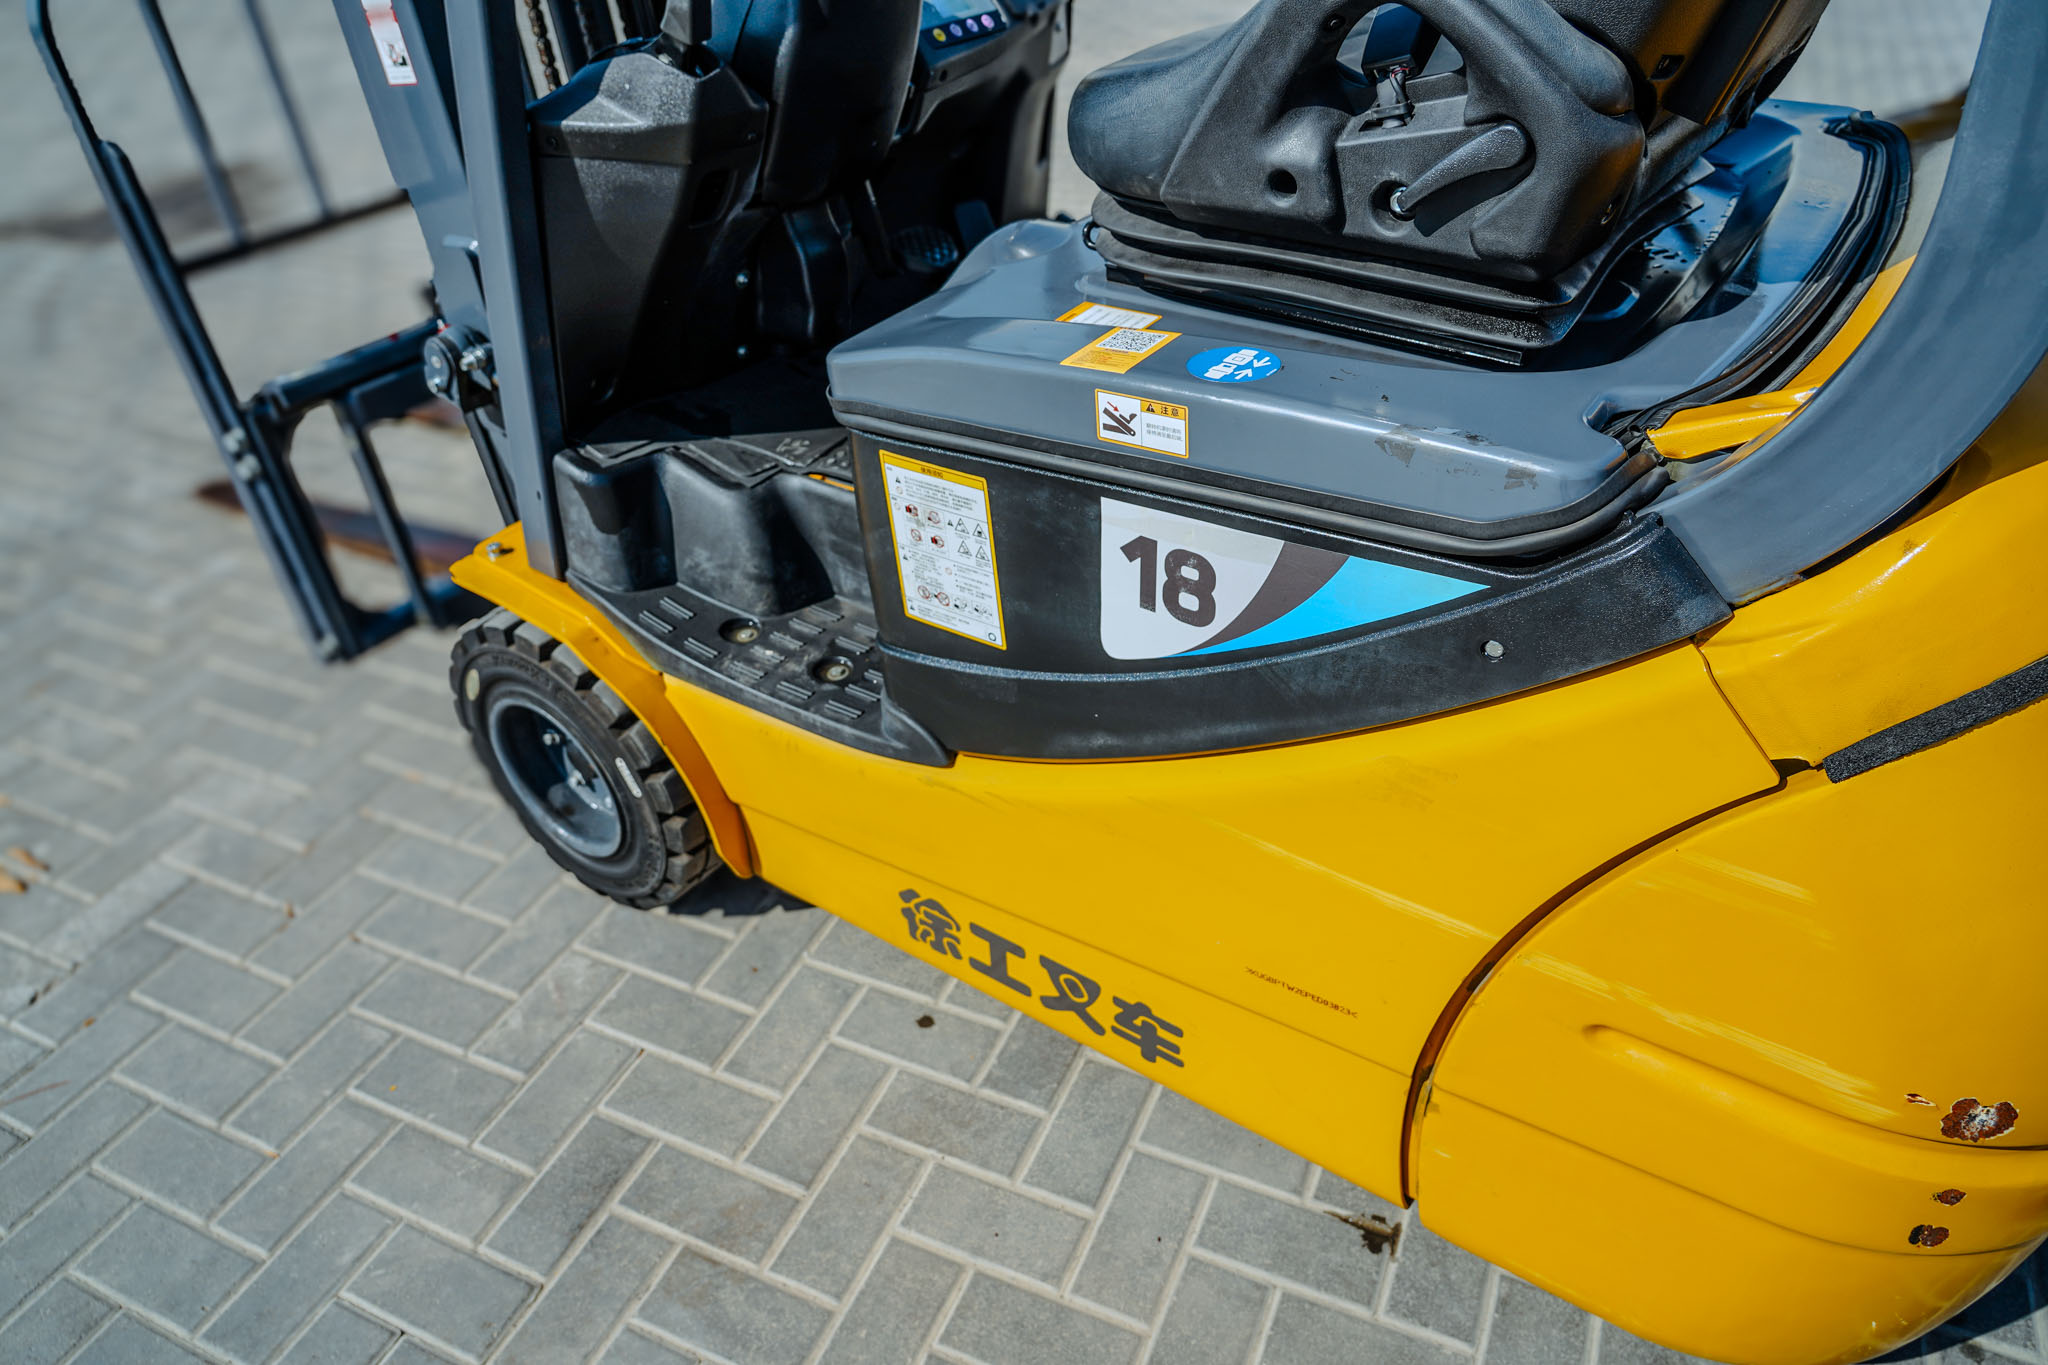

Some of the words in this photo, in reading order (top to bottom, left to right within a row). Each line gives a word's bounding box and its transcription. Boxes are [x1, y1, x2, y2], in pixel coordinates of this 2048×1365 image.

[1161, 406, 1179, 416] 注意
[1120, 535, 1217, 628] 18
[898, 888, 1185, 1068] 徐工叉车
